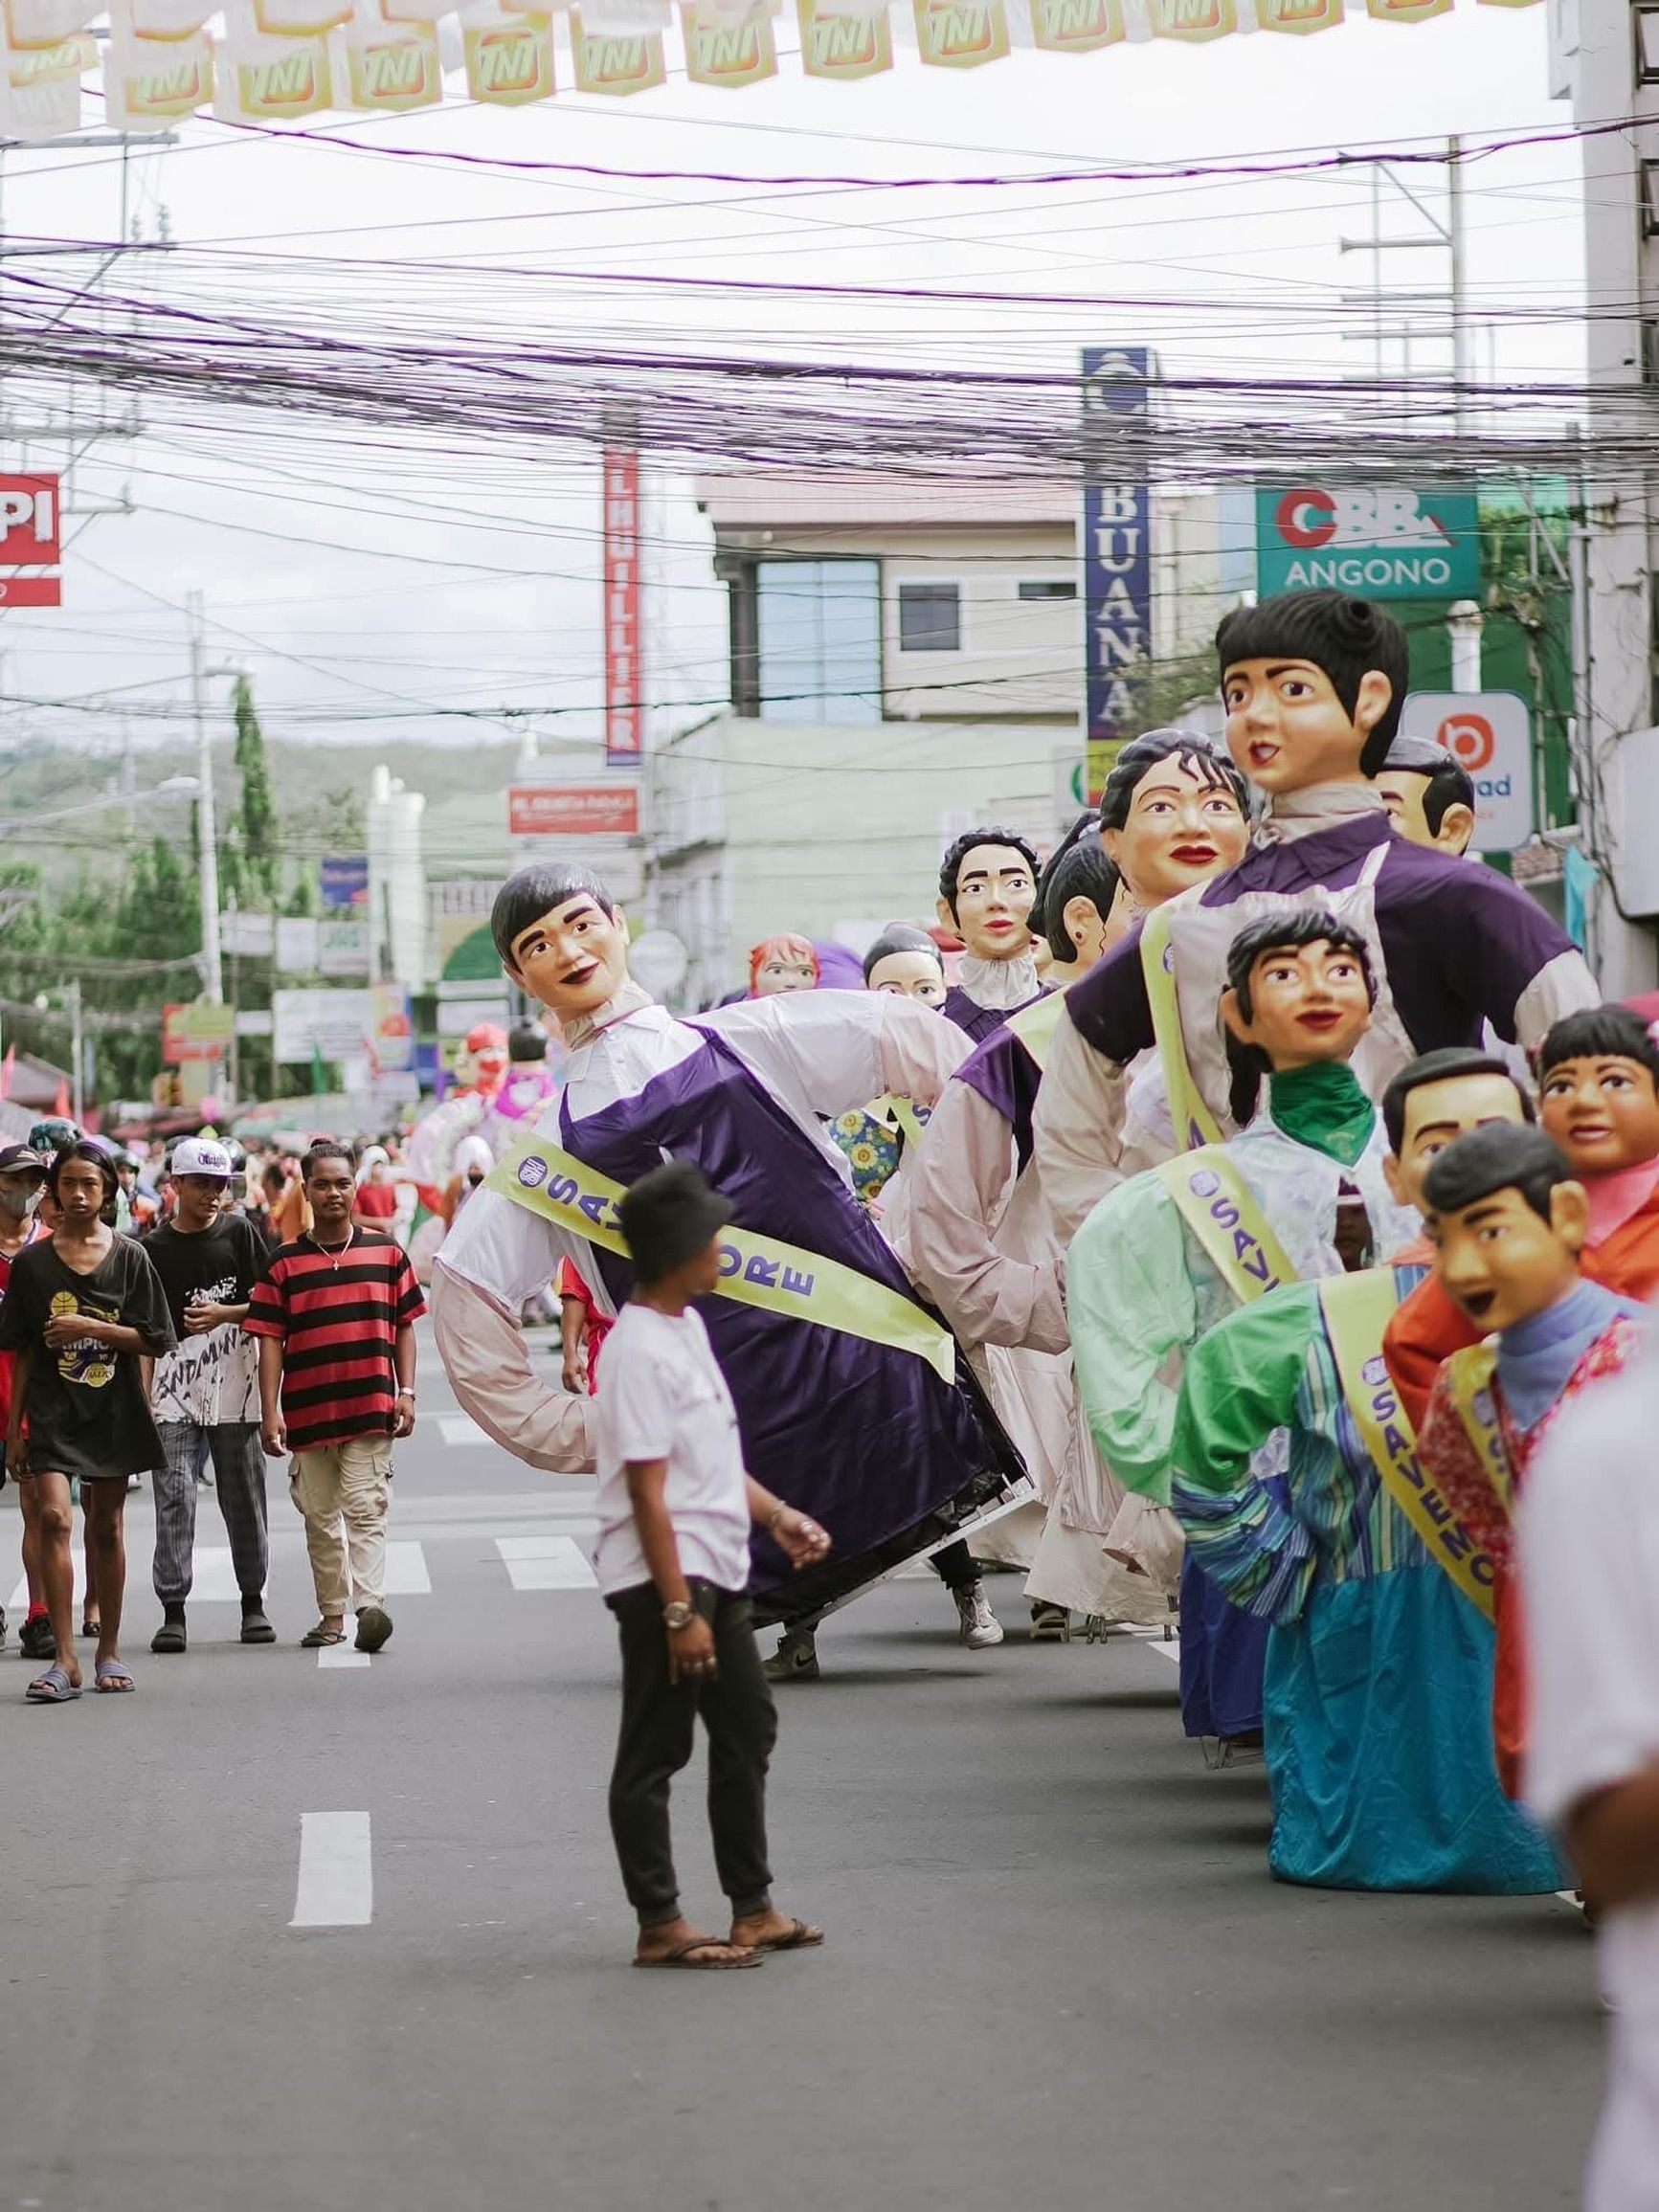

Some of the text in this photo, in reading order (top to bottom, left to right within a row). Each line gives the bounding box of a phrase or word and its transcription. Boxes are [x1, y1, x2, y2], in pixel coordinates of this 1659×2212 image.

[1286, 558, 1451, 586] ANGONO
[1477, 773, 1512, 796] ad
[1210, 1197, 1279, 1293] SAV
